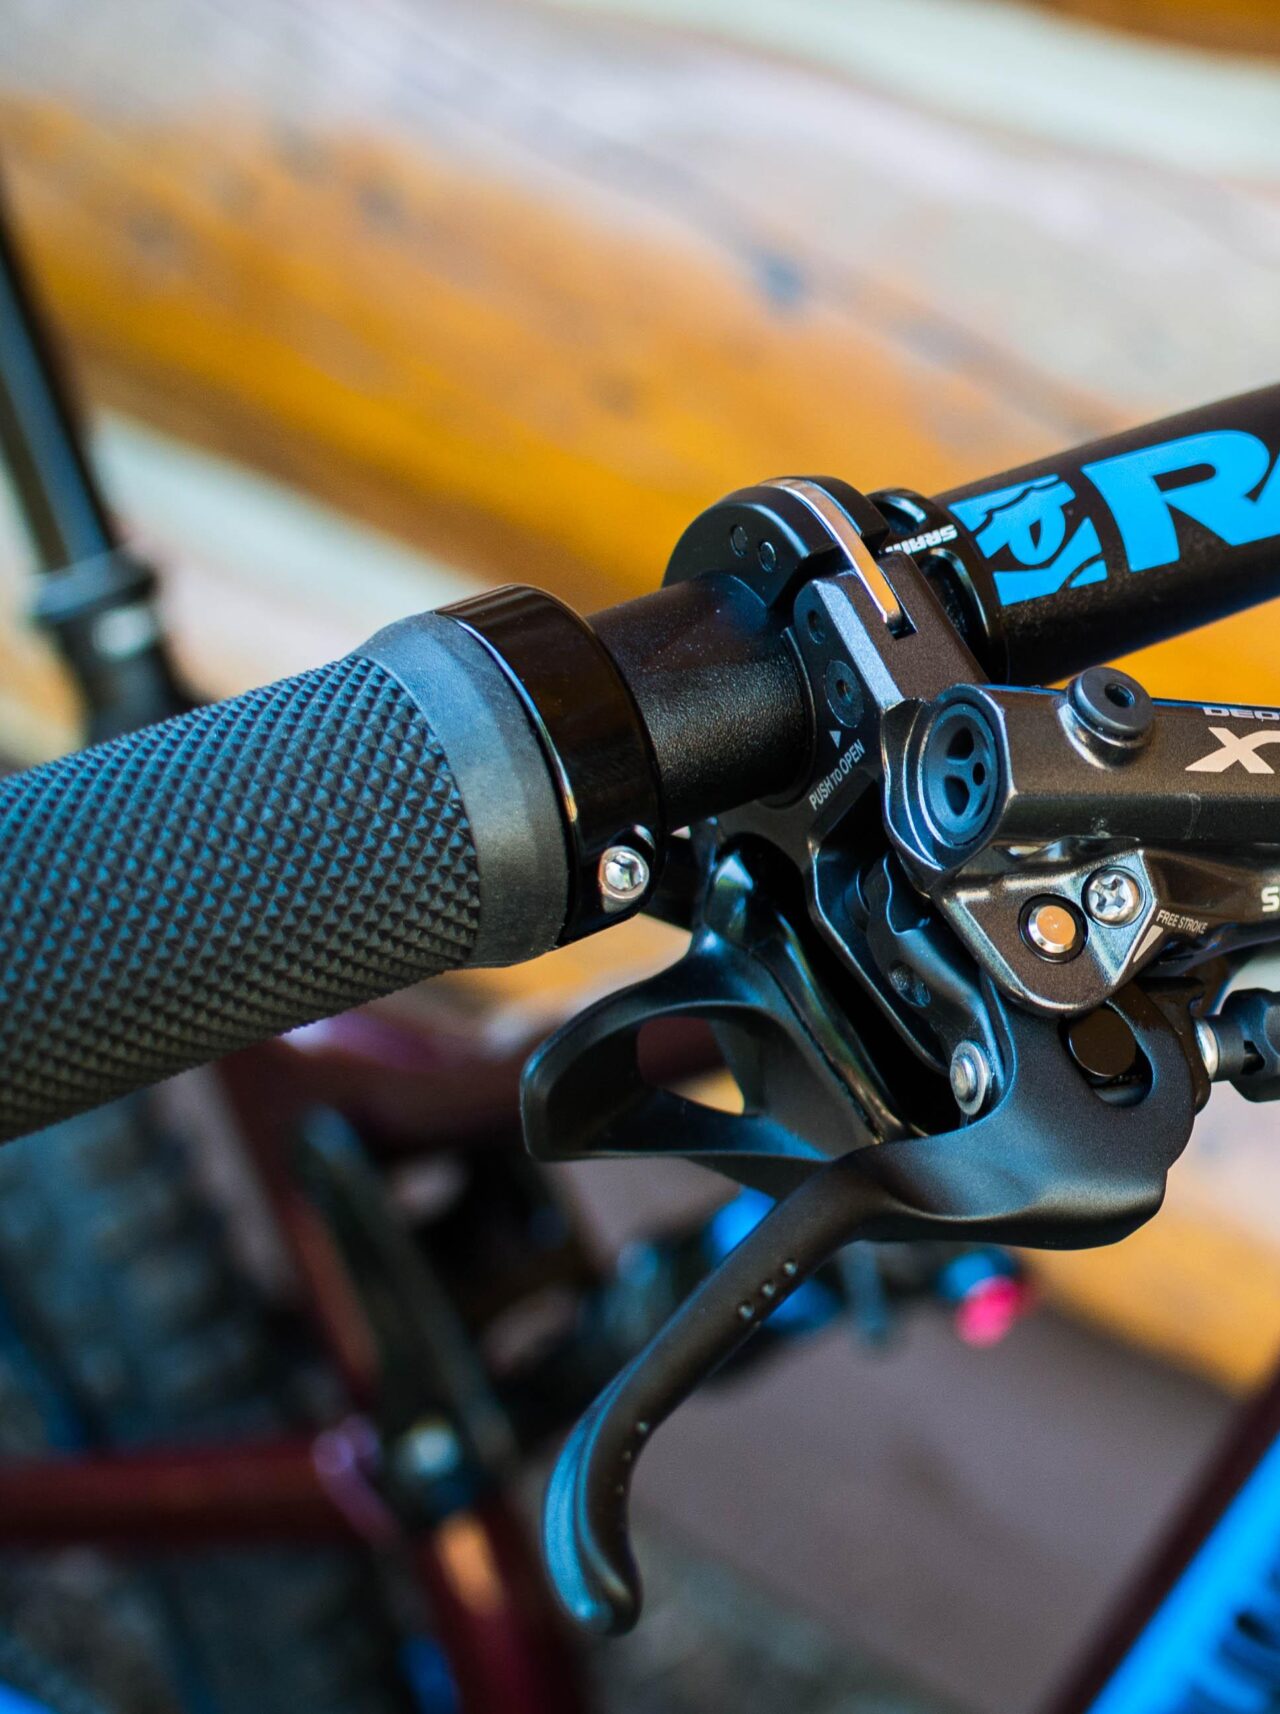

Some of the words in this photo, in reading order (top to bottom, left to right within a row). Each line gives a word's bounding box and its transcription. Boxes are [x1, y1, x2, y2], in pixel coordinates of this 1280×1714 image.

[808, 775, 834, 811] PUSH
[830, 767, 843, 786] TO
[839, 738, 866, 775] OPEN
[1156, 909, 1179, 927] FREE
[1178, 916, 1208, 934] STROKE
